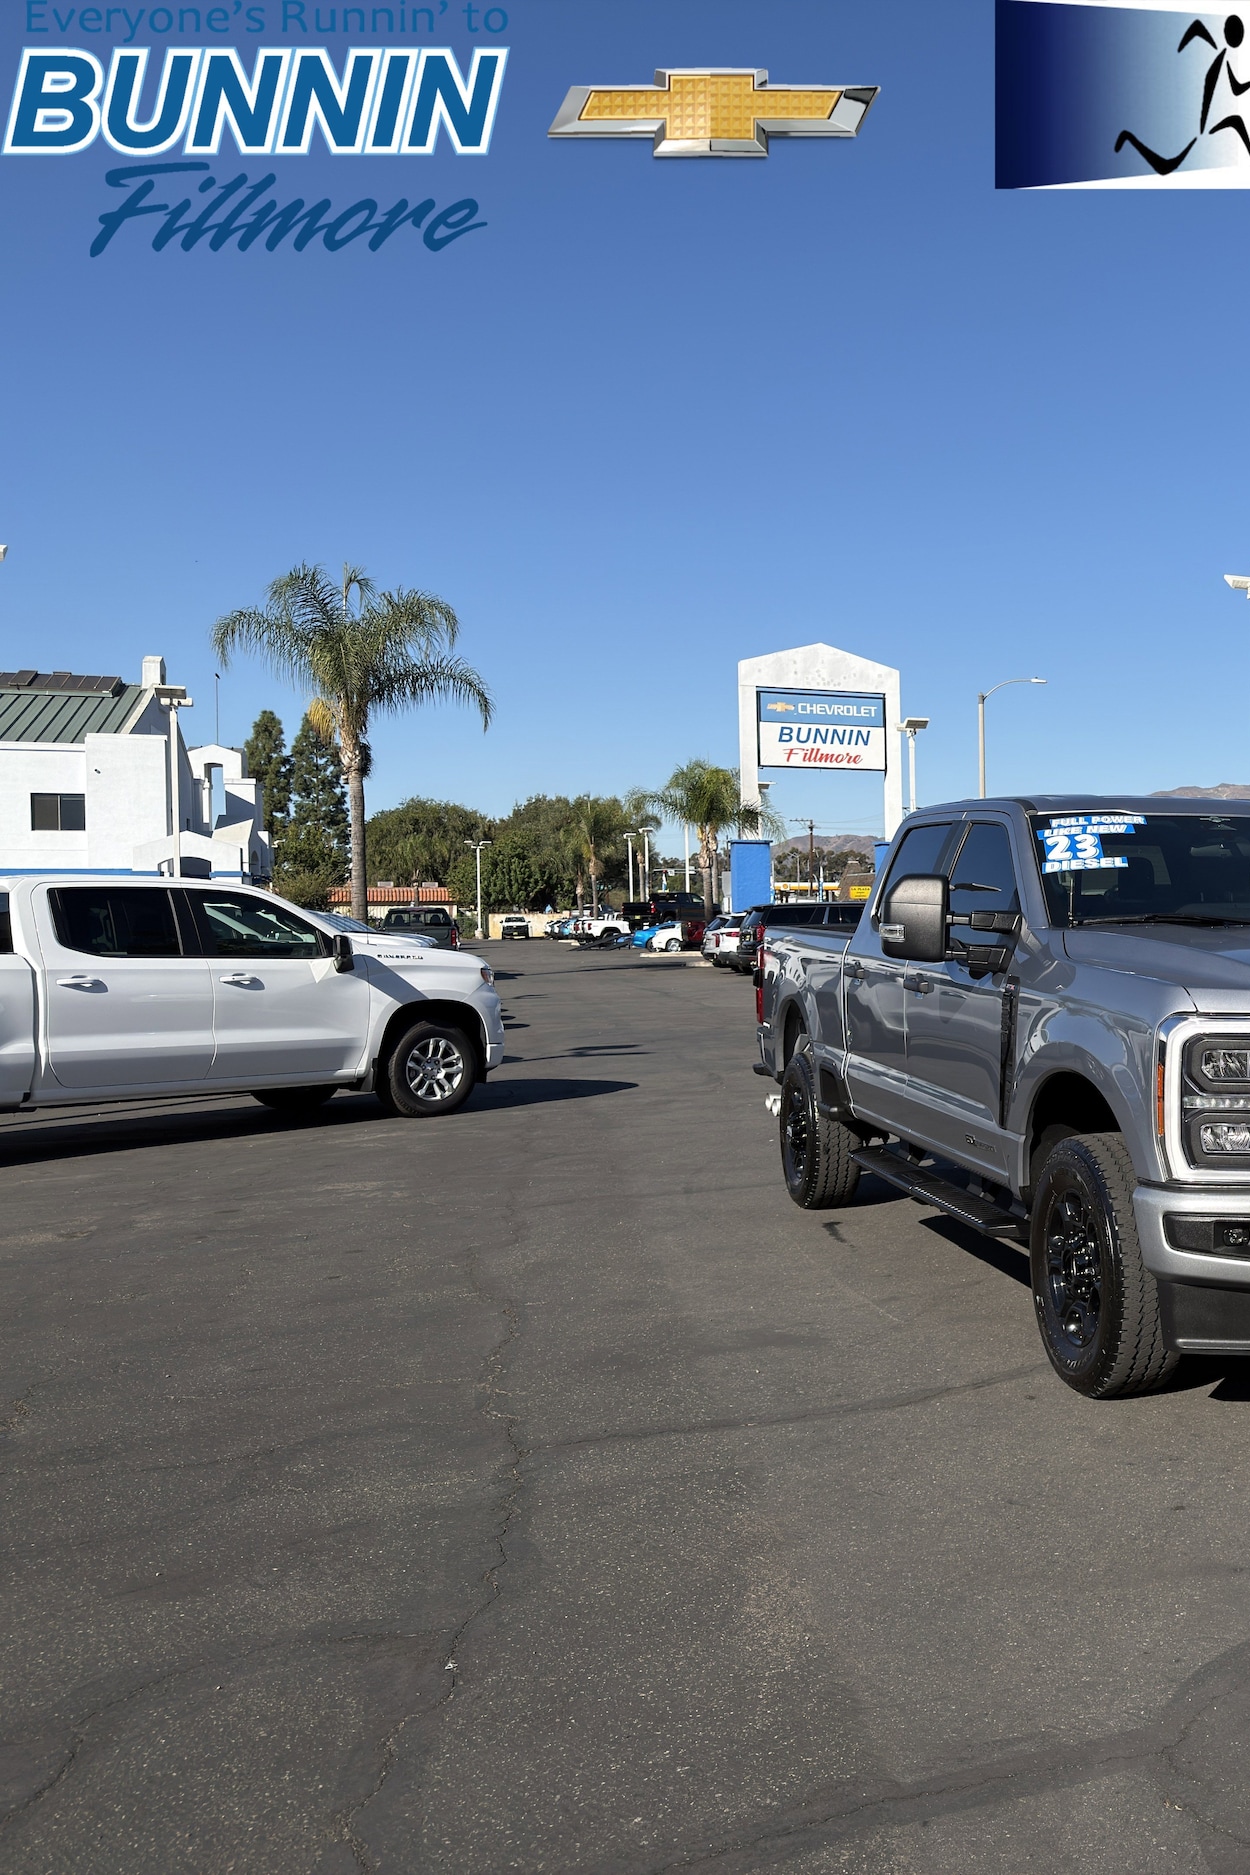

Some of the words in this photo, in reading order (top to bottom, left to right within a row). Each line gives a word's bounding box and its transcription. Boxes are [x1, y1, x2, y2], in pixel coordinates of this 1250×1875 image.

[798, 703, 877, 717] CHEVROLET
[778, 726, 871, 746] BUNNIN
[783, 748, 863, 765] Fillmore
[1051, 816, 1089, 827] FULL
[1091, 815, 1145, 825] POWER
[1043, 826, 1082, 837] LIKE
[1086, 824, 1128, 834] NEW
[1045, 833, 1101, 861] 23
[1045, 856, 1129, 874] DIESEL
